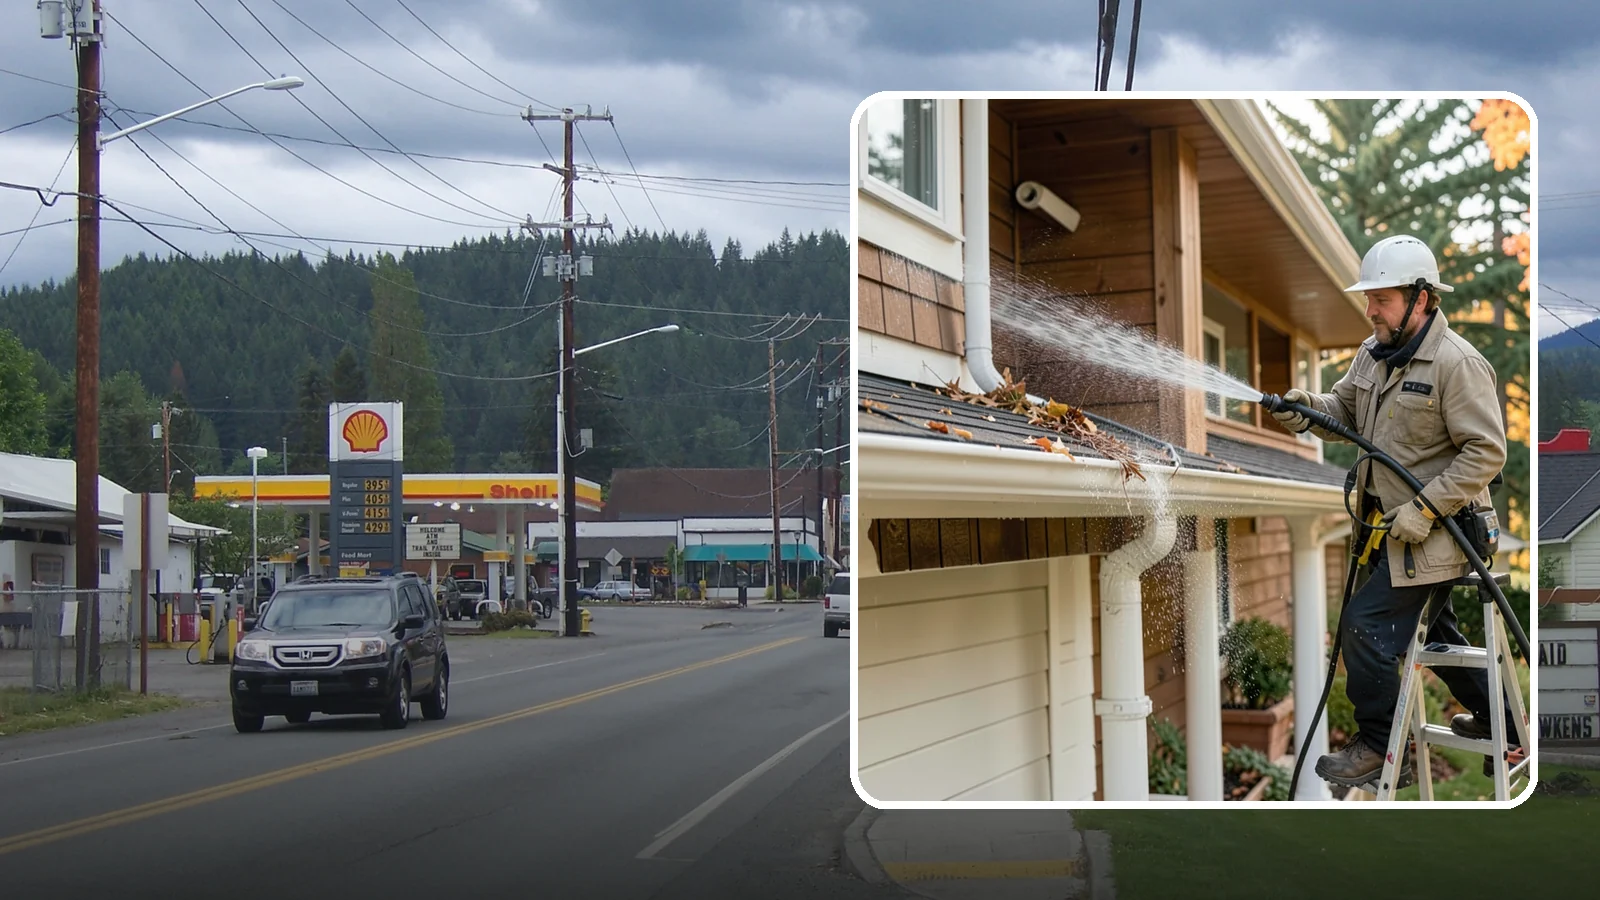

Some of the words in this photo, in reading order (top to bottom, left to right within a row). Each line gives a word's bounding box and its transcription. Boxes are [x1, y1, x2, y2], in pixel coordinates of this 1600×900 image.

[366, 480, 383, 490] 395
[490, 484, 547, 499] Shell
[366, 494, 383, 504] 405
[366, 508, 383, 518] 415
[366, 522, 383, 533] 429
